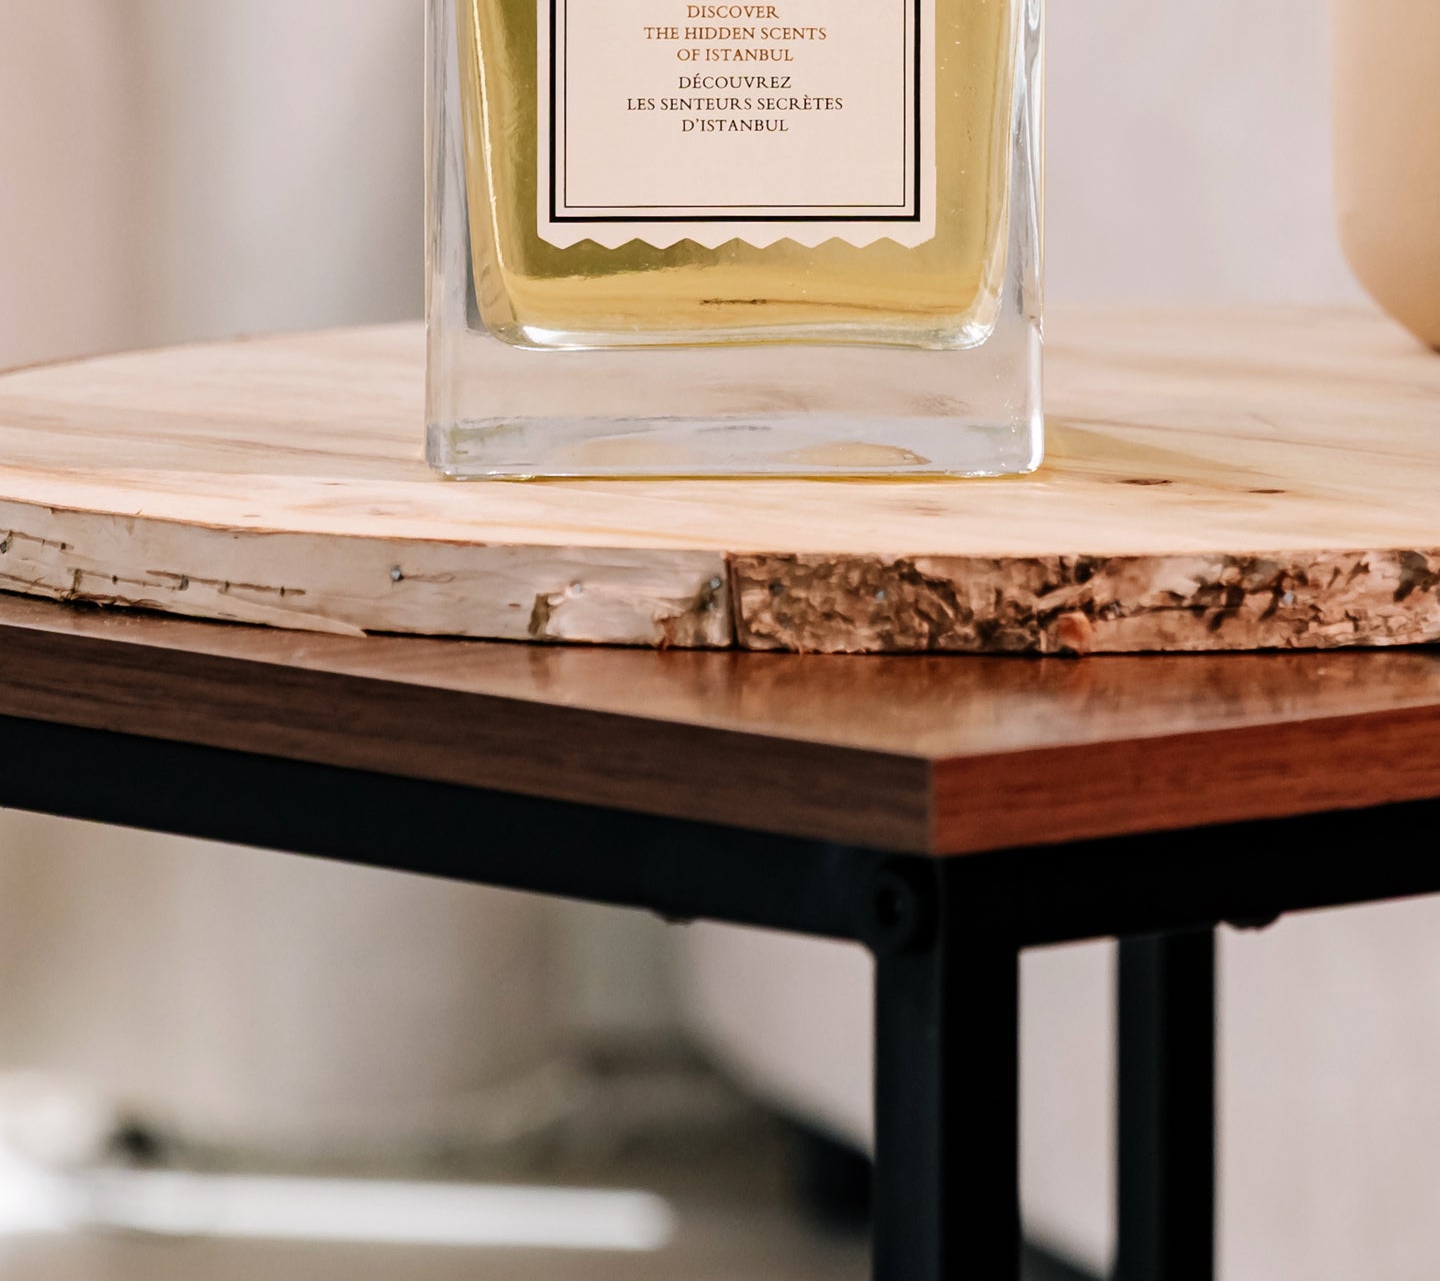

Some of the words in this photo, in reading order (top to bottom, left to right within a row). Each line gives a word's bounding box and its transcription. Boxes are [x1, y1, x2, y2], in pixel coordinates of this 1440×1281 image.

[686, 4, 780, 20] DISCOVER
[643, 26, 680, 41] THE
[683, 26, 756, 41] HIDDEN
[760, 26, 827, 41] SCENTS
[676, 48, 701, 62] OF
[705, 48, 794, 62] ISTANBUL
[678, 72, 792, 90] DÉCOUVREZ
[626, 97, 656, 111] LES
[660, 97, 753, 111] SENTEURS
[756, 94, 844, 111] SECRÈTES
